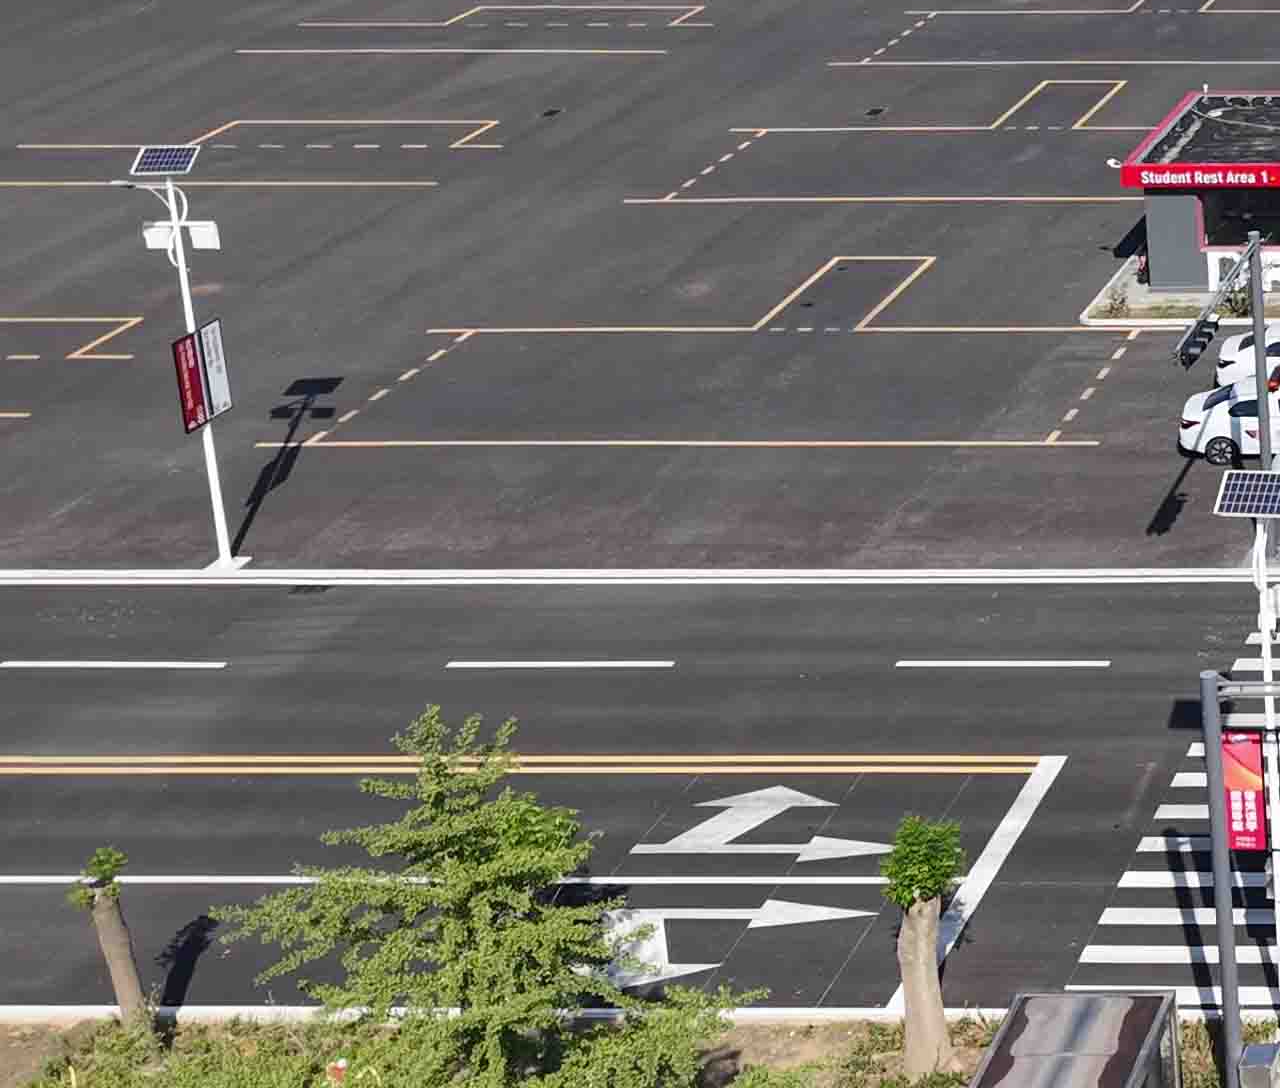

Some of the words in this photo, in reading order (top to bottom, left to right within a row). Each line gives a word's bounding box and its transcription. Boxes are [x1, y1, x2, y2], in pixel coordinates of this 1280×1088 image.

[1140, 170, 1192, 184] Student
[1194, 170, 1224, 184] Rest
[1226, 170, 1256, 184] Area
[1261, 169, 1269, 183] 1
